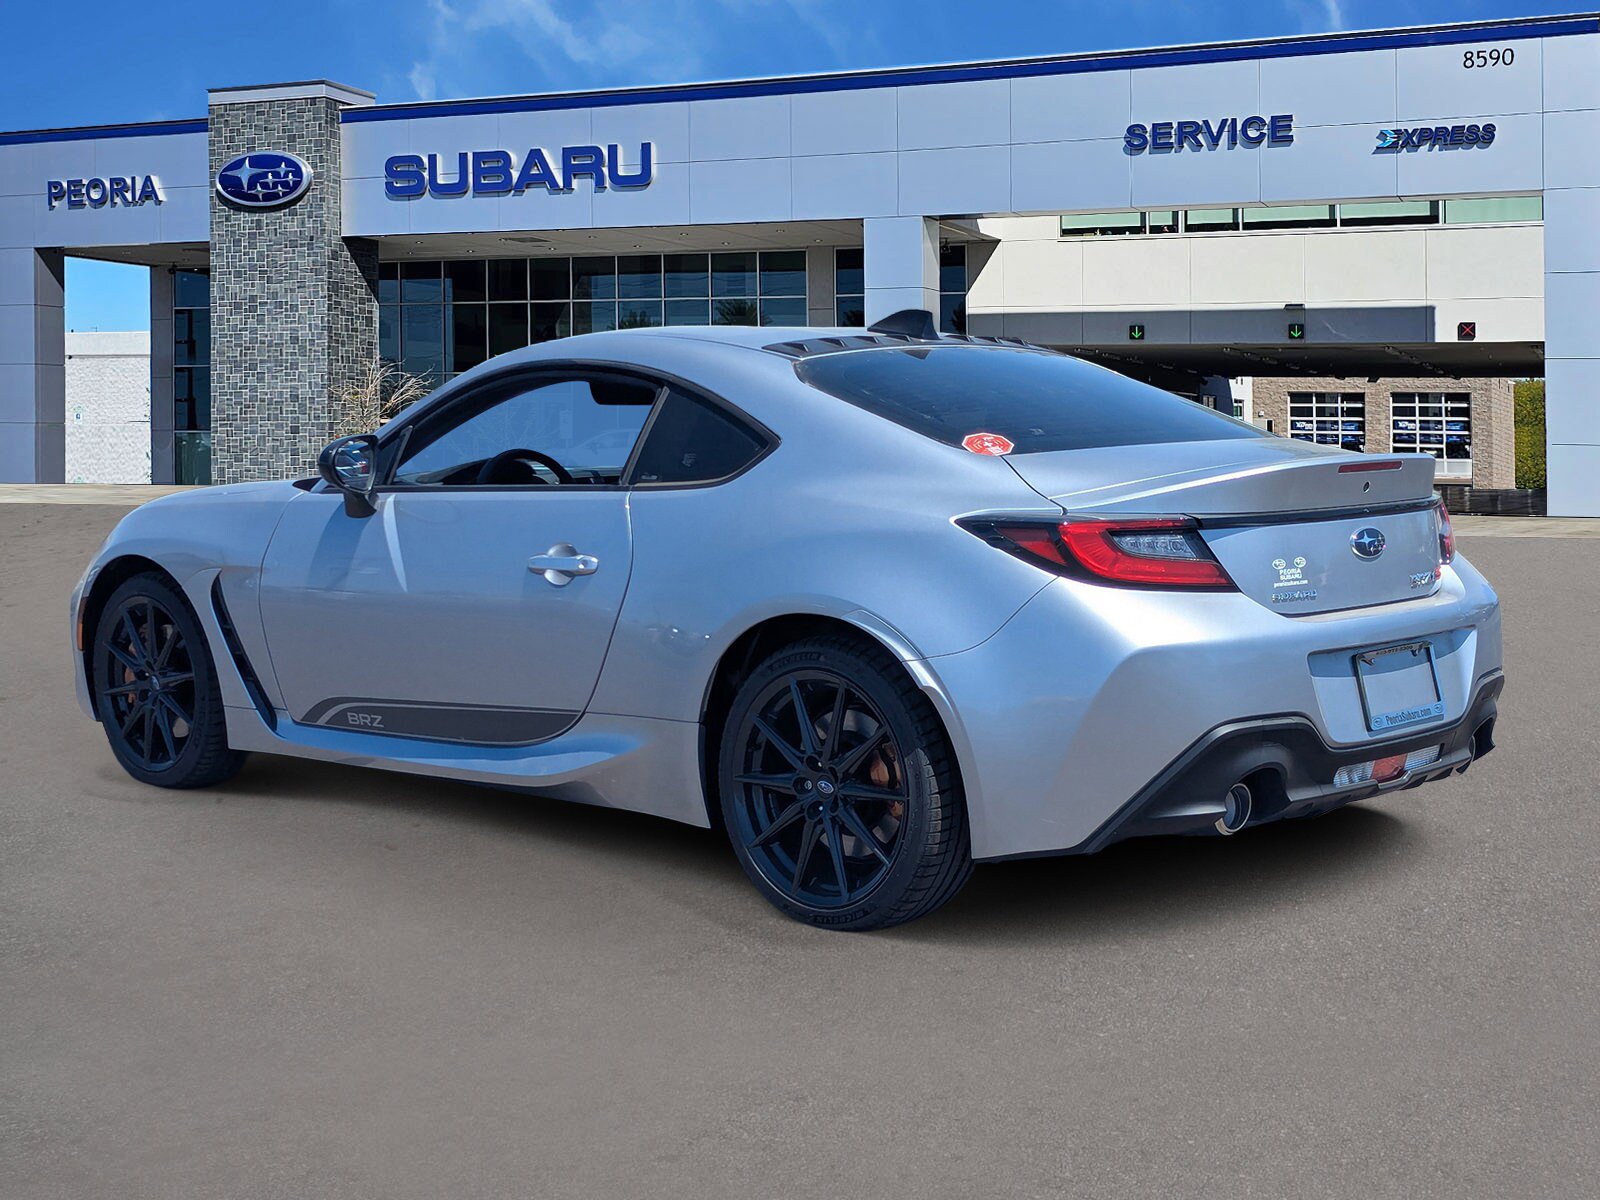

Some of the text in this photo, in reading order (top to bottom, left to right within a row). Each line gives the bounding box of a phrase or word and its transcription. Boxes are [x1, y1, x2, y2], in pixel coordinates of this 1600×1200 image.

[1463, 48, 1515, 69] 8590
[1124, 115, 1294, 154] SERVICE
[1375, 123, 1497, 150] EXPRESS
[385, 142, 652, 200] SUBARU
[47, 175, 163, 210] PEORIA
[347, 712, 384, 728] BRZ
[1385, 707, 1433, 726] PeoriaSubaru.com
